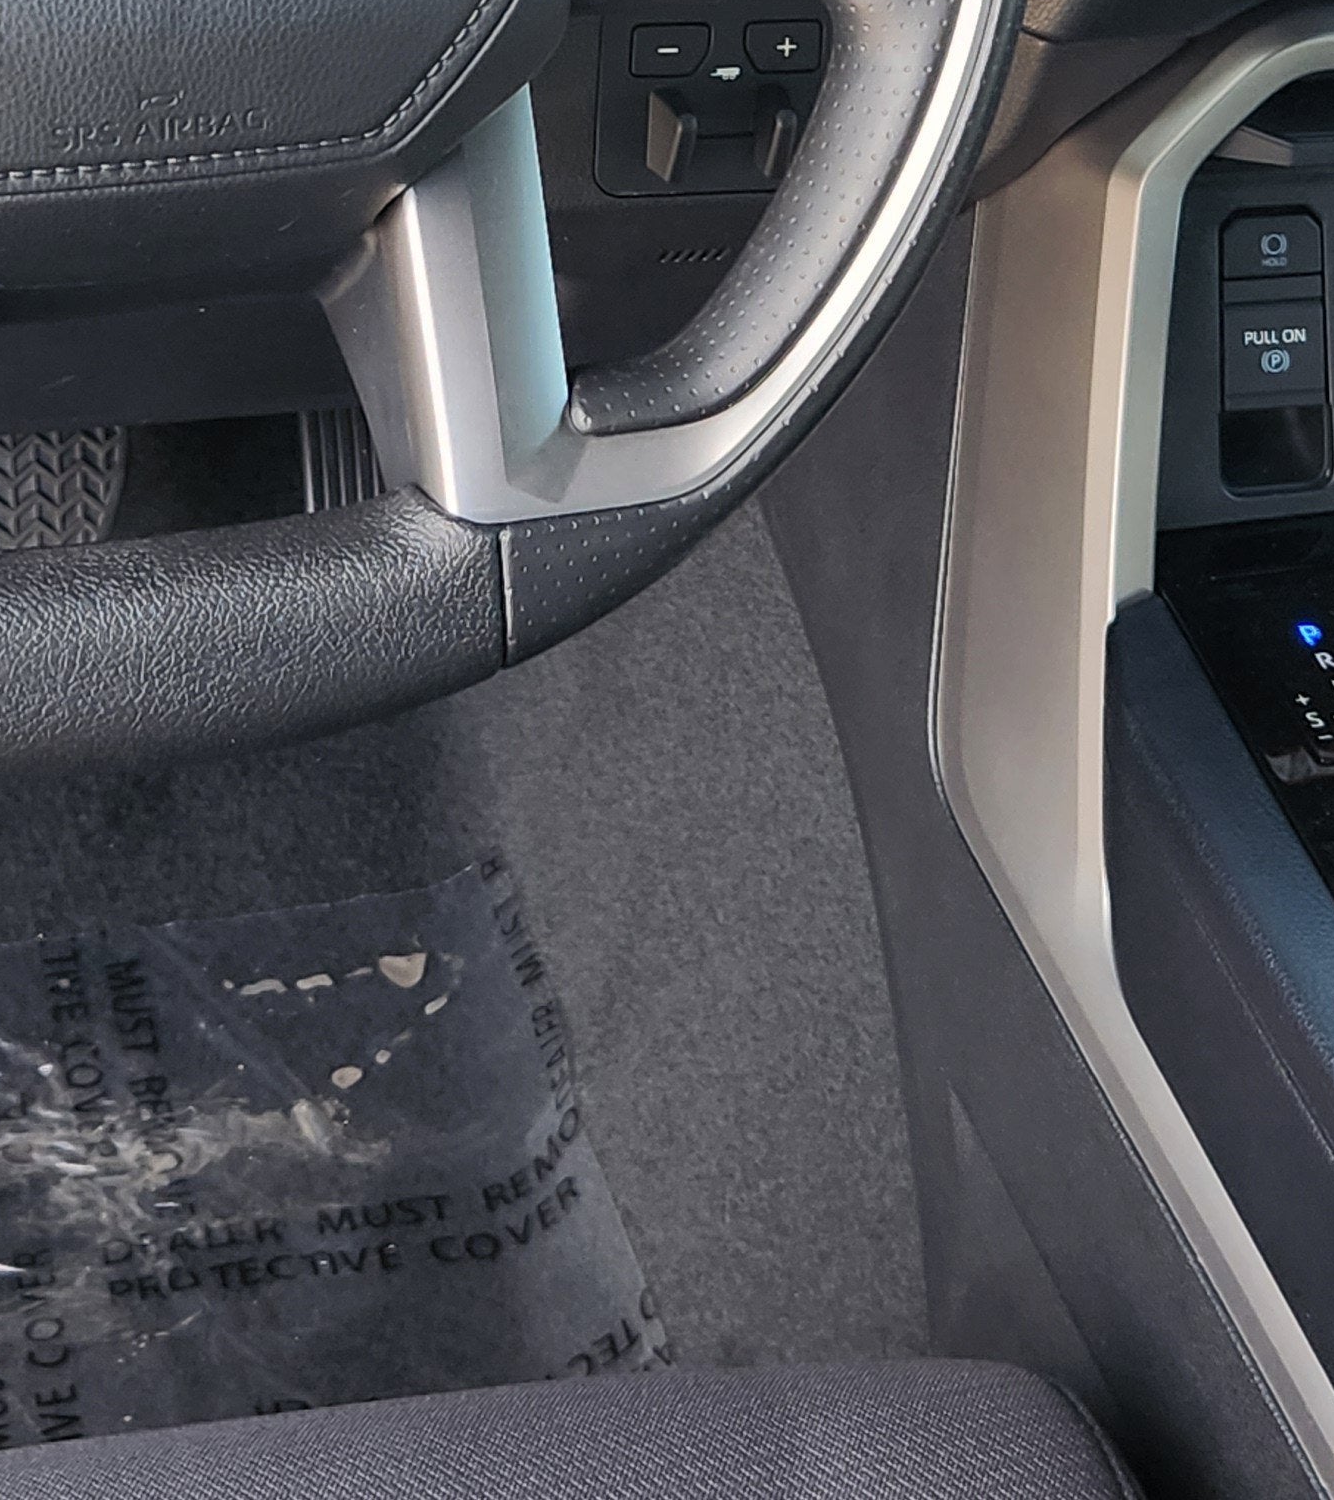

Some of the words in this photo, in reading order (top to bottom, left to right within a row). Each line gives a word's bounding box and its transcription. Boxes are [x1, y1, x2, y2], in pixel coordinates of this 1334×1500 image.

[51, 120, 123, 152] SRS
[133, 108, 269, 144] AIRBAG
[1243, 329, 1278, 346] PULL
[1281, 327, 1307, 345] ON
[1297, 623, 1321, 645] P
[1305, 710, 1326, 729] S
[315, 1194, 452, 1236] MUST
[108, 1242, 403, 1298] PROTECTIVE
[429, 1174, 581, 1262] COVER
